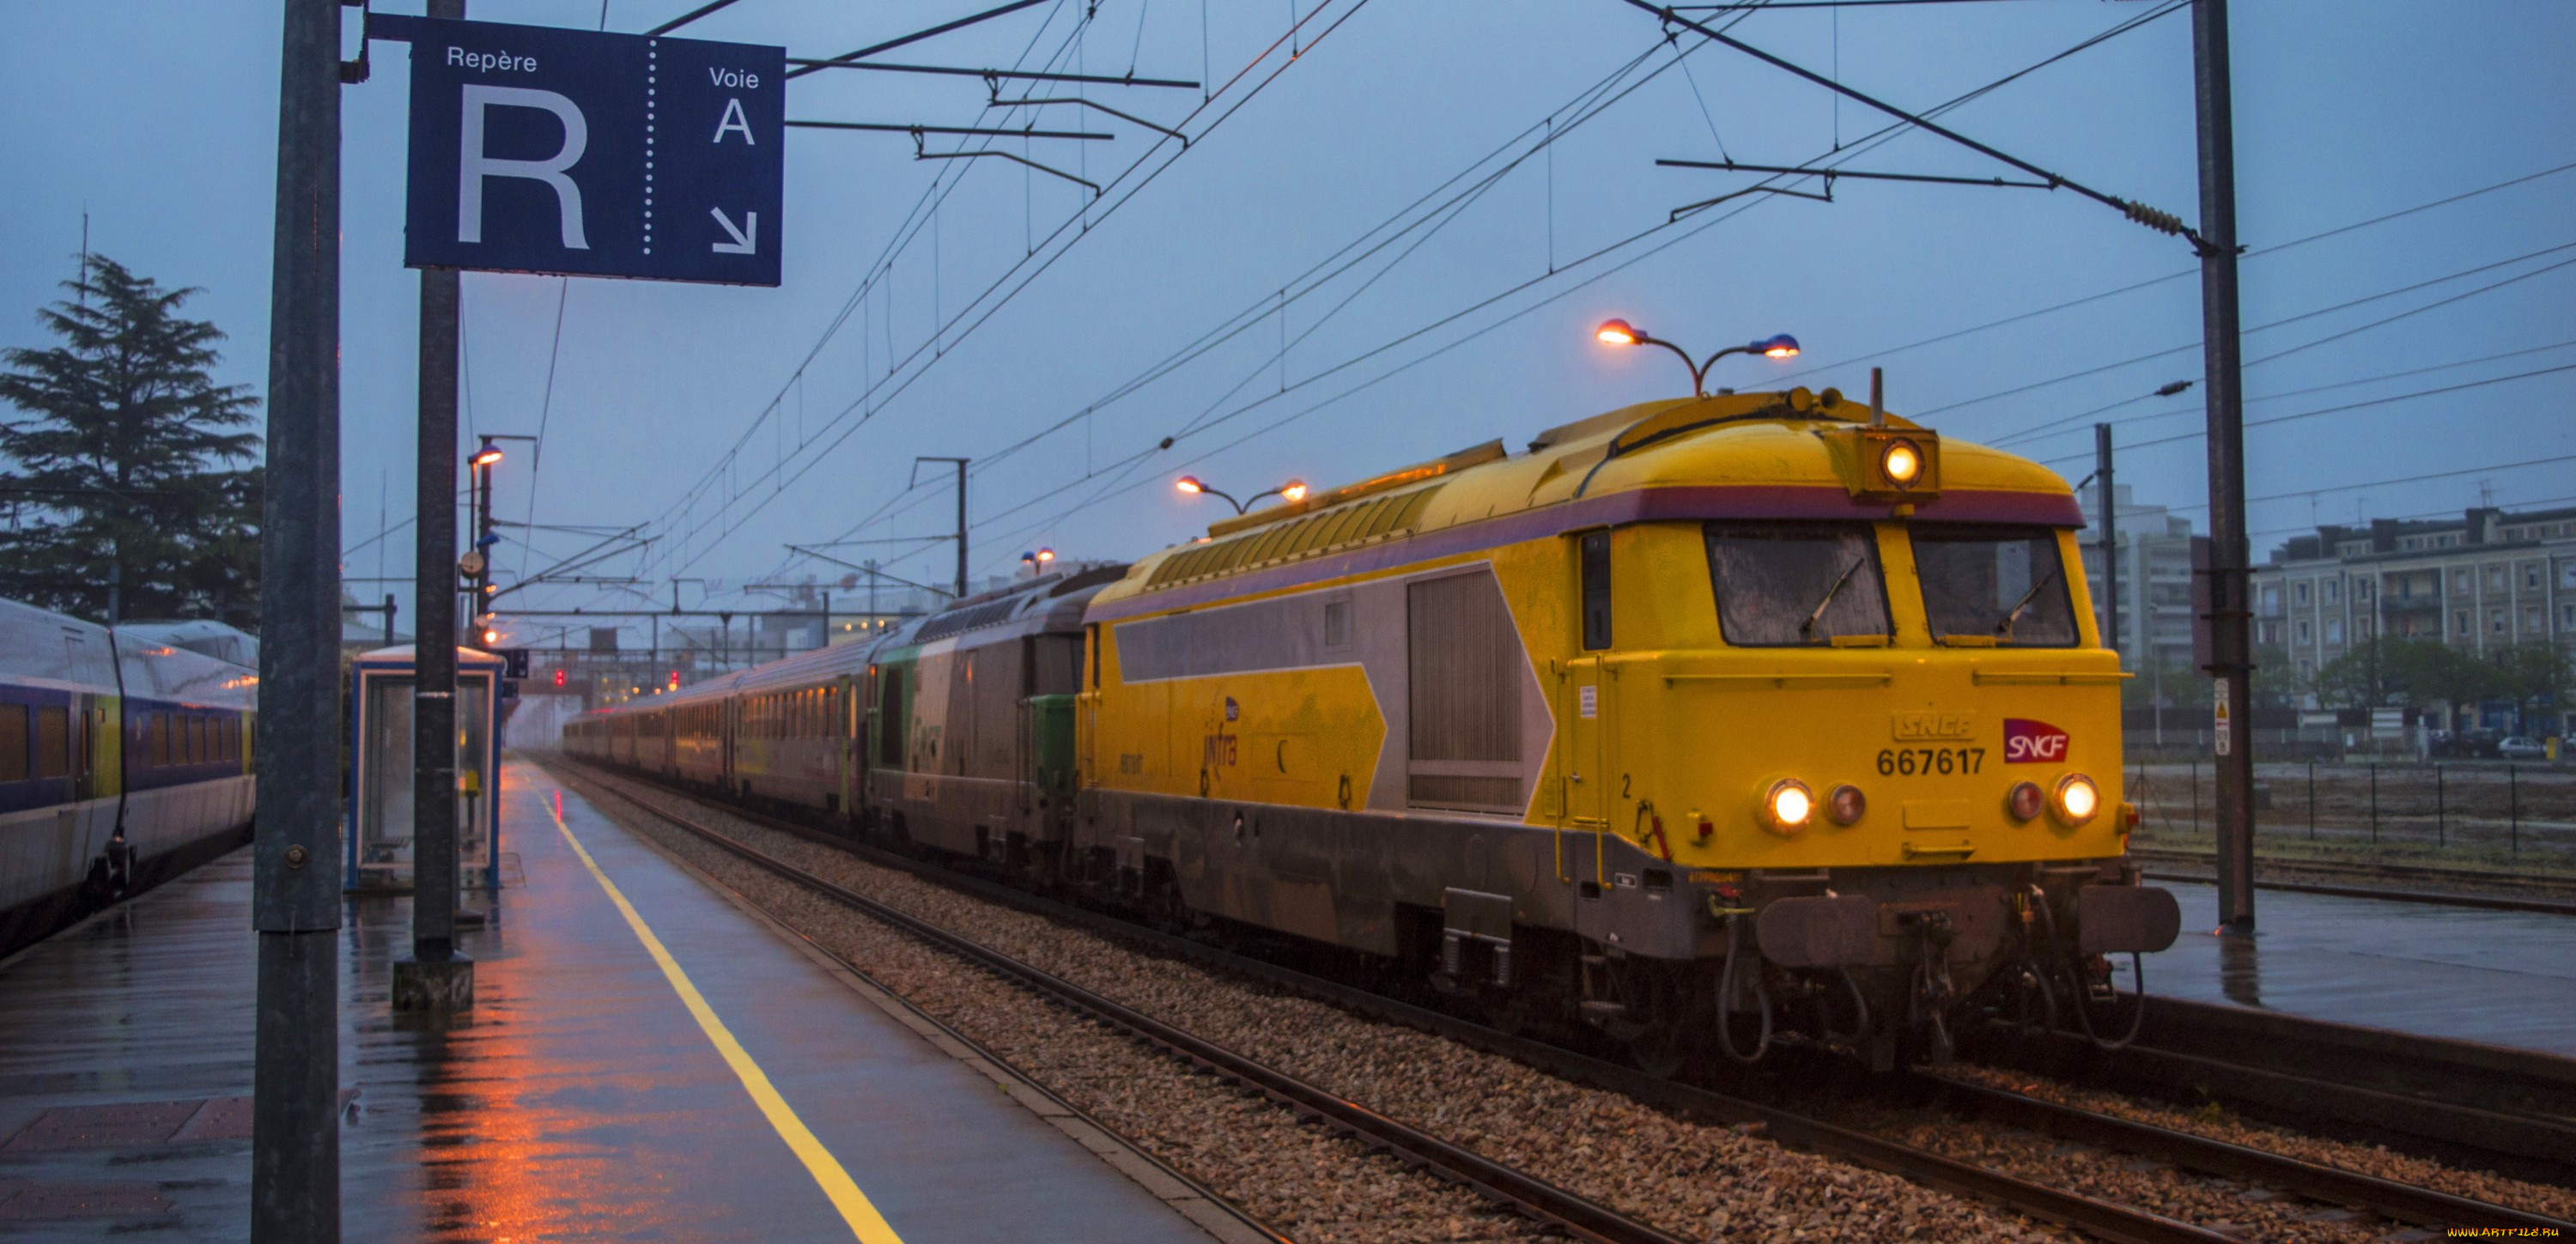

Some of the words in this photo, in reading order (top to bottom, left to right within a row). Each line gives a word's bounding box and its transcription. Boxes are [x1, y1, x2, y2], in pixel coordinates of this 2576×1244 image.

[447, 46, 538, 73] Repère
[709, 67, 759, 89] Voie
[713, 98, 755, 146] A
[458, 83, 590, 250] R
[2007, 735, 2066, 758] SNCF
[1877, 748, 1986, 775] 667617
[1622, 773, 1631, 798] 2
